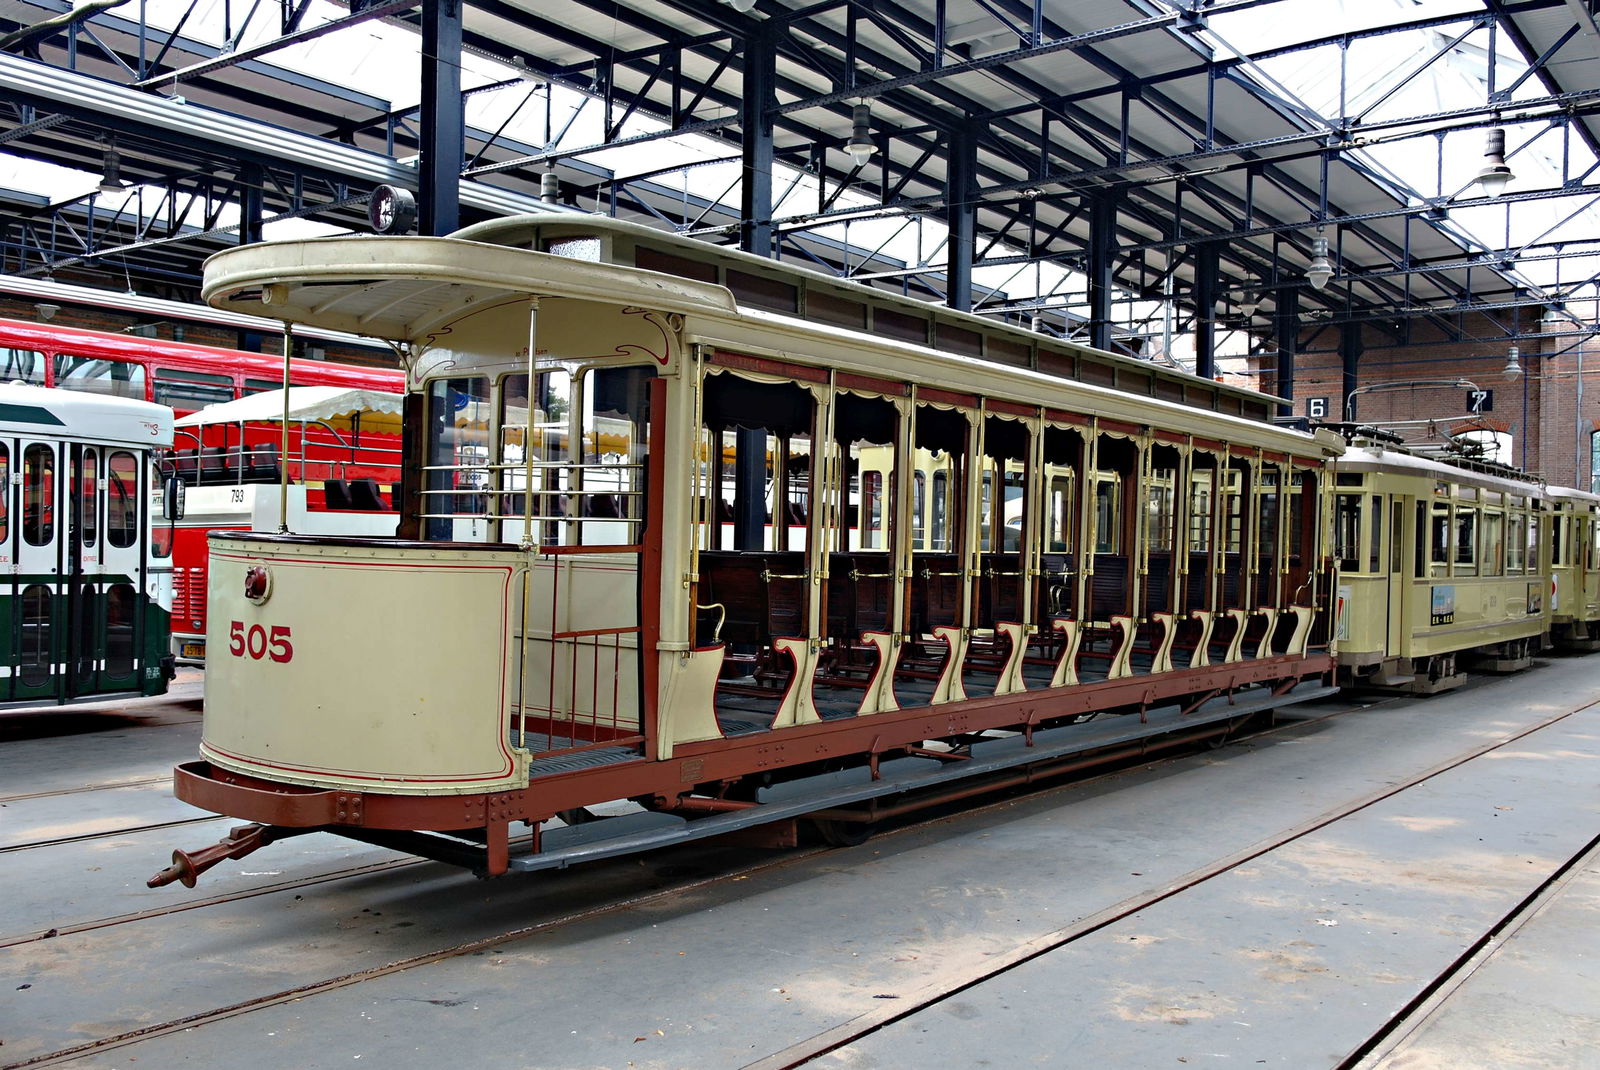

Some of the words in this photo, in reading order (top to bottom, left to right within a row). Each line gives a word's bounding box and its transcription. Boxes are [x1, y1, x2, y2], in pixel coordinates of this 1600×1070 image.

[1310, 398, 1324, 417] 6
[1472, 391, 1487, 411] 7
[231, 489, 245, 503] 793
[229, 620, 294, 664] 505
